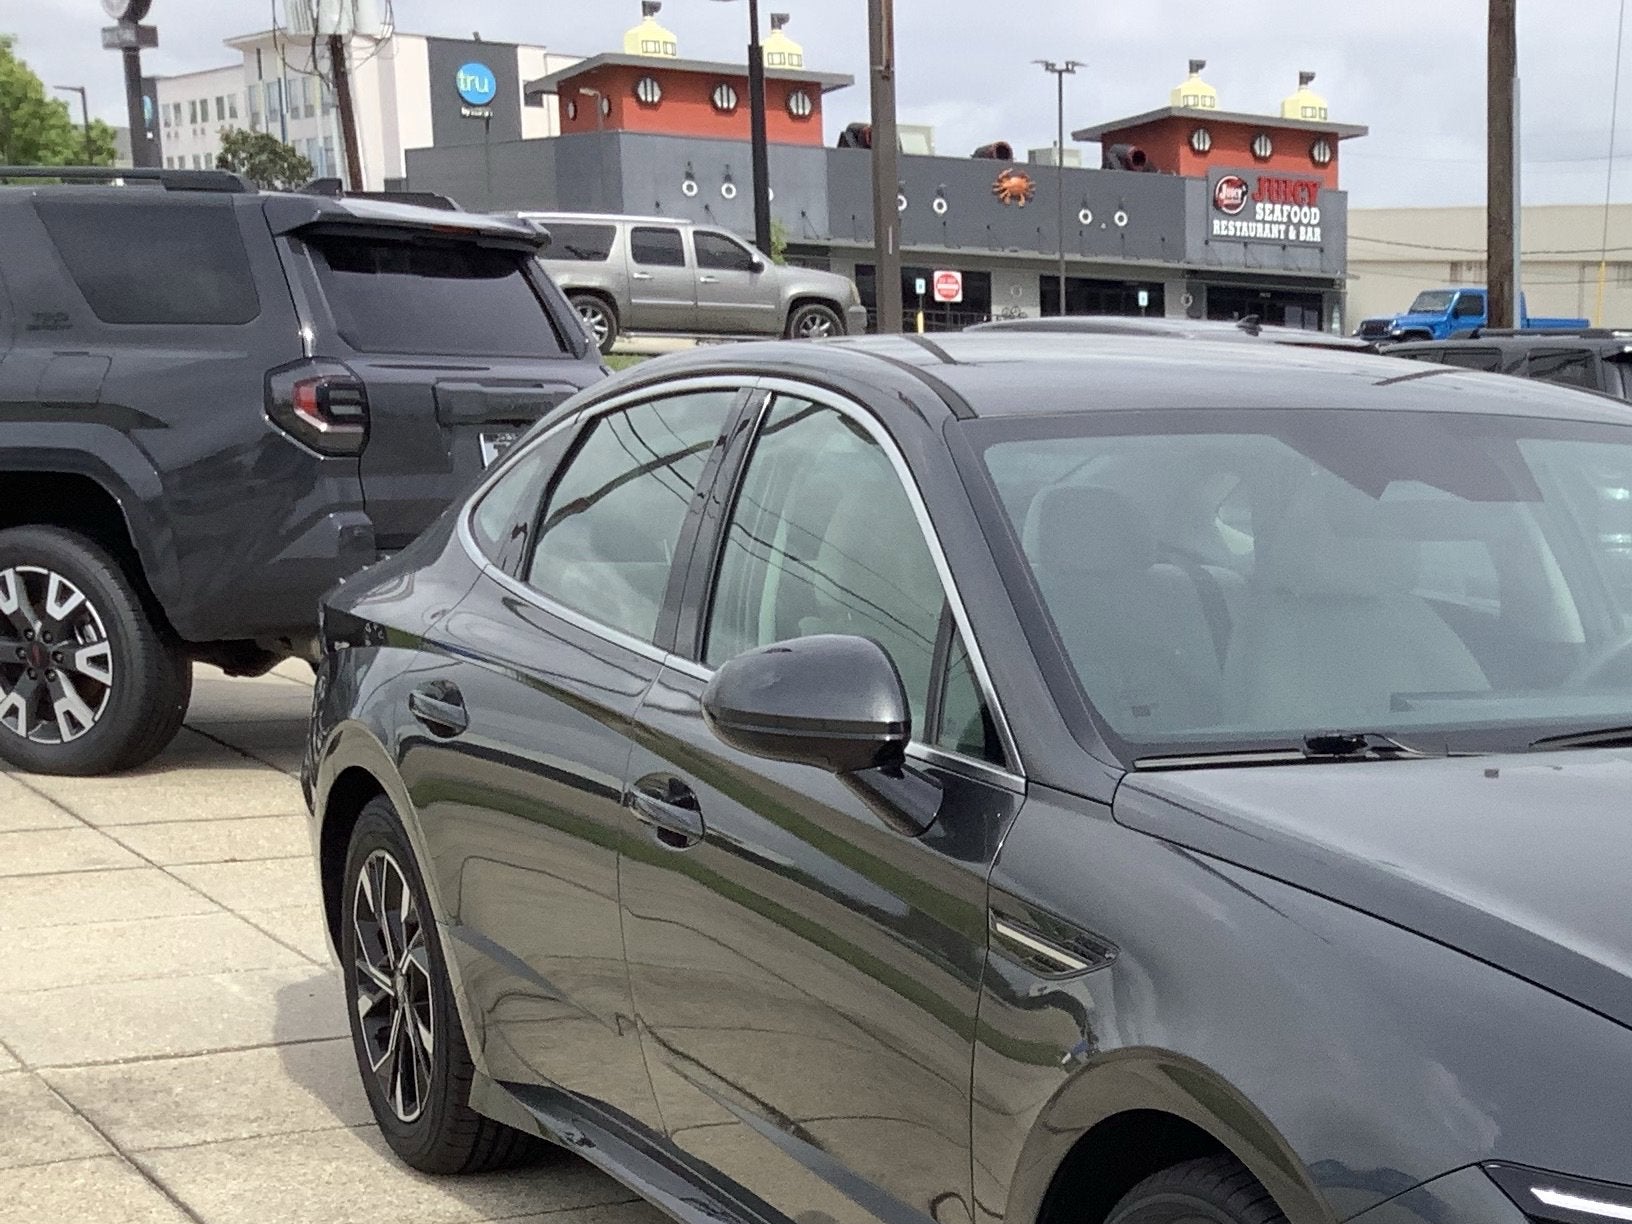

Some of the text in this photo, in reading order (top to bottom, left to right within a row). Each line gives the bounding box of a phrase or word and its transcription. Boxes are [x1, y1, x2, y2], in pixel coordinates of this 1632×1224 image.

[457, 69, 489, 93] tru
[1252, 176, 1318, 207] JUICY
[1255, 203, 1320, 225] SEAFOOD
[1212, 219, 1321, 242] RESTAURANT & BAR
